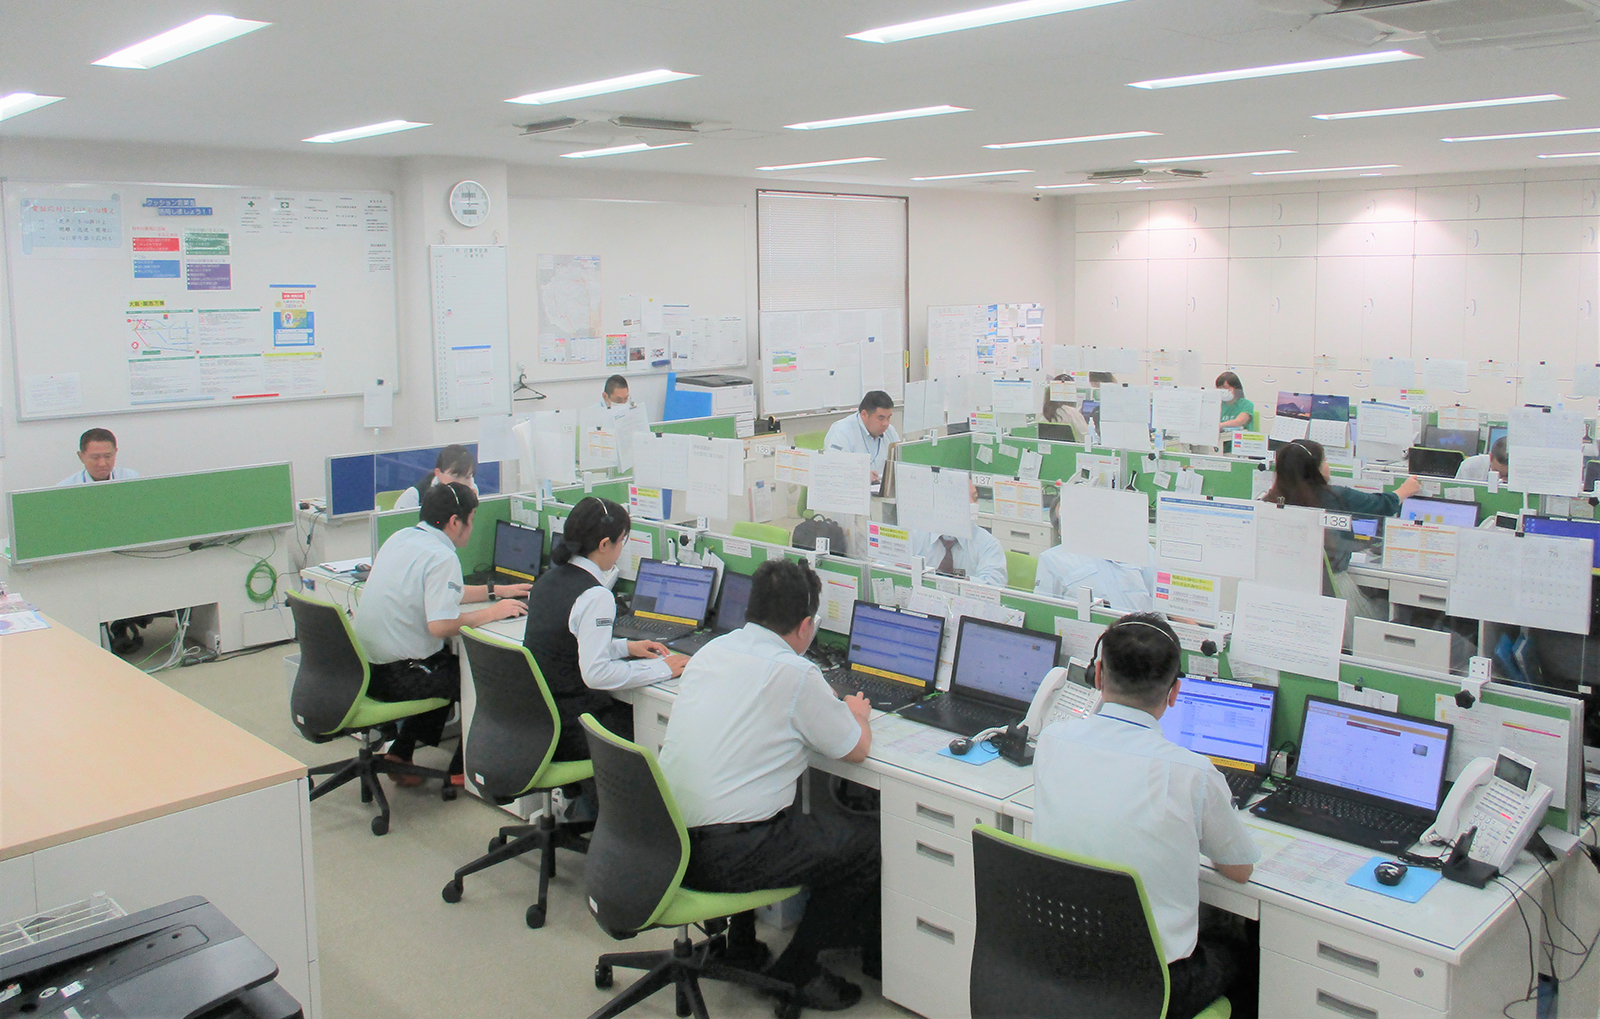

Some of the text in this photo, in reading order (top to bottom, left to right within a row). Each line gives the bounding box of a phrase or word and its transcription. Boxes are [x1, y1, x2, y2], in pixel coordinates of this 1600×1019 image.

[756, 445, 770, 455] 136
[974, 475, 992, 485] 137
[1322, 515, 1348, 528] 138
